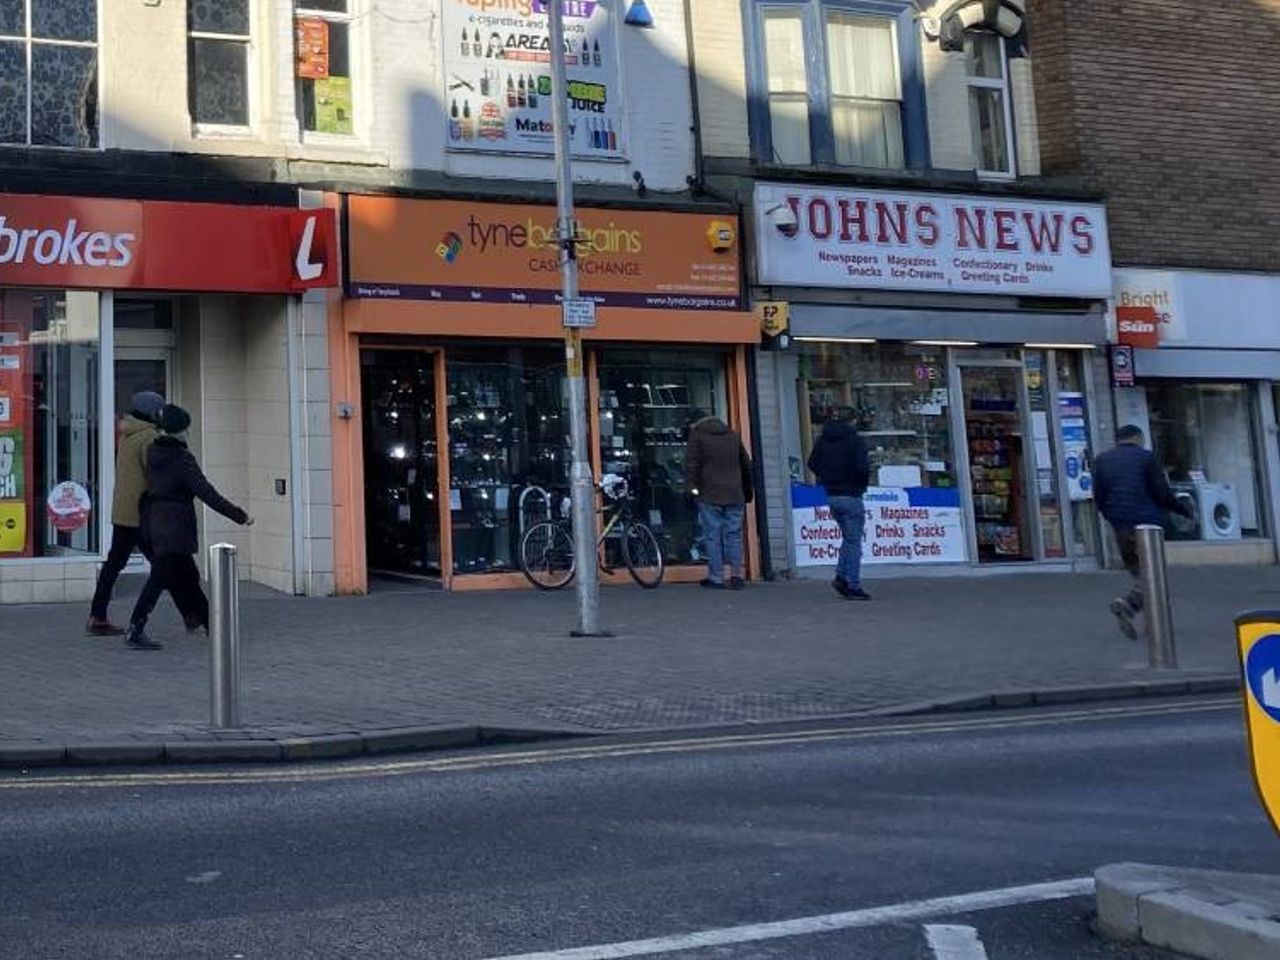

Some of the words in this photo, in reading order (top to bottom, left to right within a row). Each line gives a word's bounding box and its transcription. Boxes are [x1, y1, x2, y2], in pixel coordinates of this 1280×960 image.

[954, 206, 1094, 255] NEWS
[819, 251, 878, 265] Newspapers
[887, 254, 937, 268] Magazines
[1025, 261, 1054, 273] Drinks
[847, 265, 883, 277] Snacks
[891, 267, 945, 281] Ice-Creams
[960, 270, 1001, 285] Greeting
[1003, 272, 1030, 284] Cards
[1120, 288, 1171, 306] Bright
[880, 506, 929, 522] Magazines
[875, 524, 905, 539] Drinks
[913, 524, 946, 537] Snacks
[871, 542, 911, 560] Greeting
[914, 542, 942, 557] Cards
